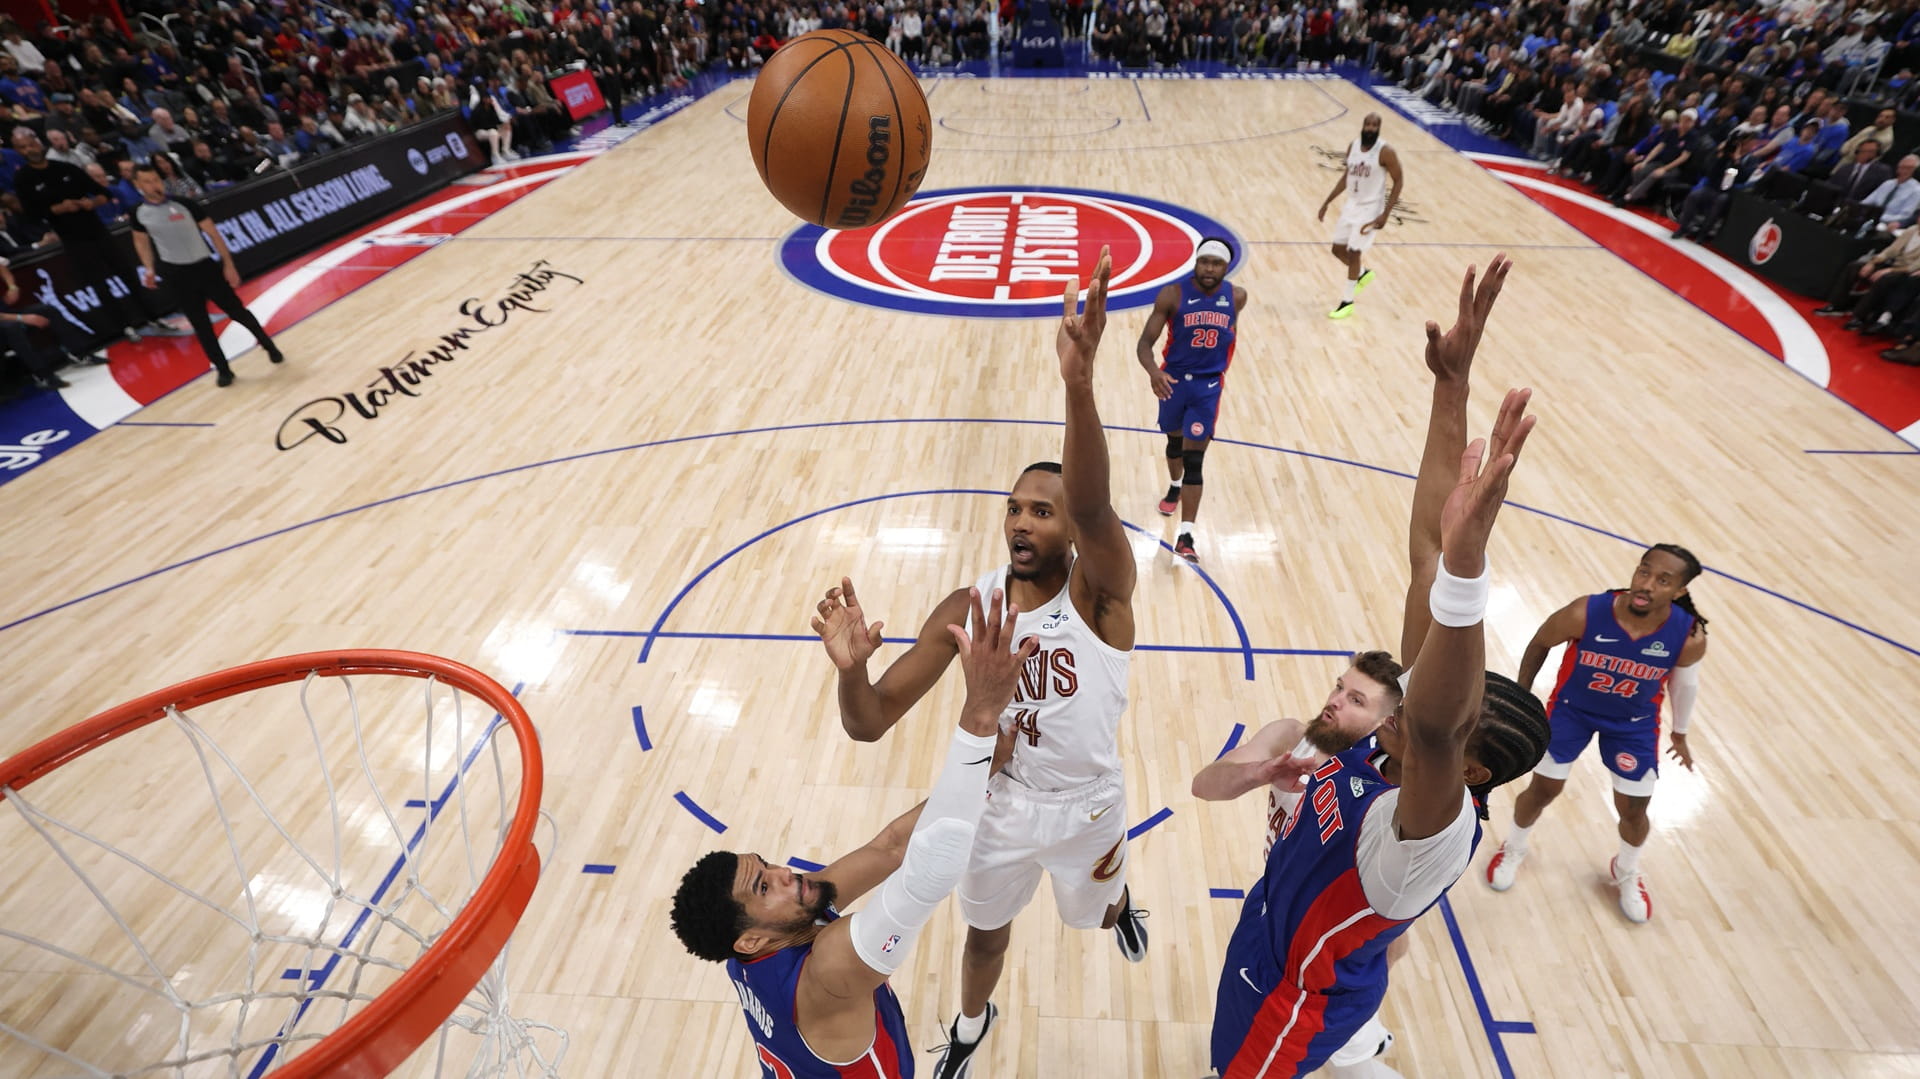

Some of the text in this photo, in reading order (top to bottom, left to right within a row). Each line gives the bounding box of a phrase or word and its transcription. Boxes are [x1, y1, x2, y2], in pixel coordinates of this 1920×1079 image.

[837, 115, 890, 226] Wilson
[263, 199, 305, 234] ALL
[290, 178, 354, 222] SEASON
[929, 205, 1010, 282] DETROIT
[1009, 205, 1079, 283] PISTONS
[1184, 311, 1230, 328] DETROIT
[1191, 328, 1219, 348] 28
[276, 259, 584, 450] Platinum Equity
[1014, 647, 1079, 702] VS
[1579, 650, 1668, 680] DETROIT
[1588, 672, 1639, 698] 24
